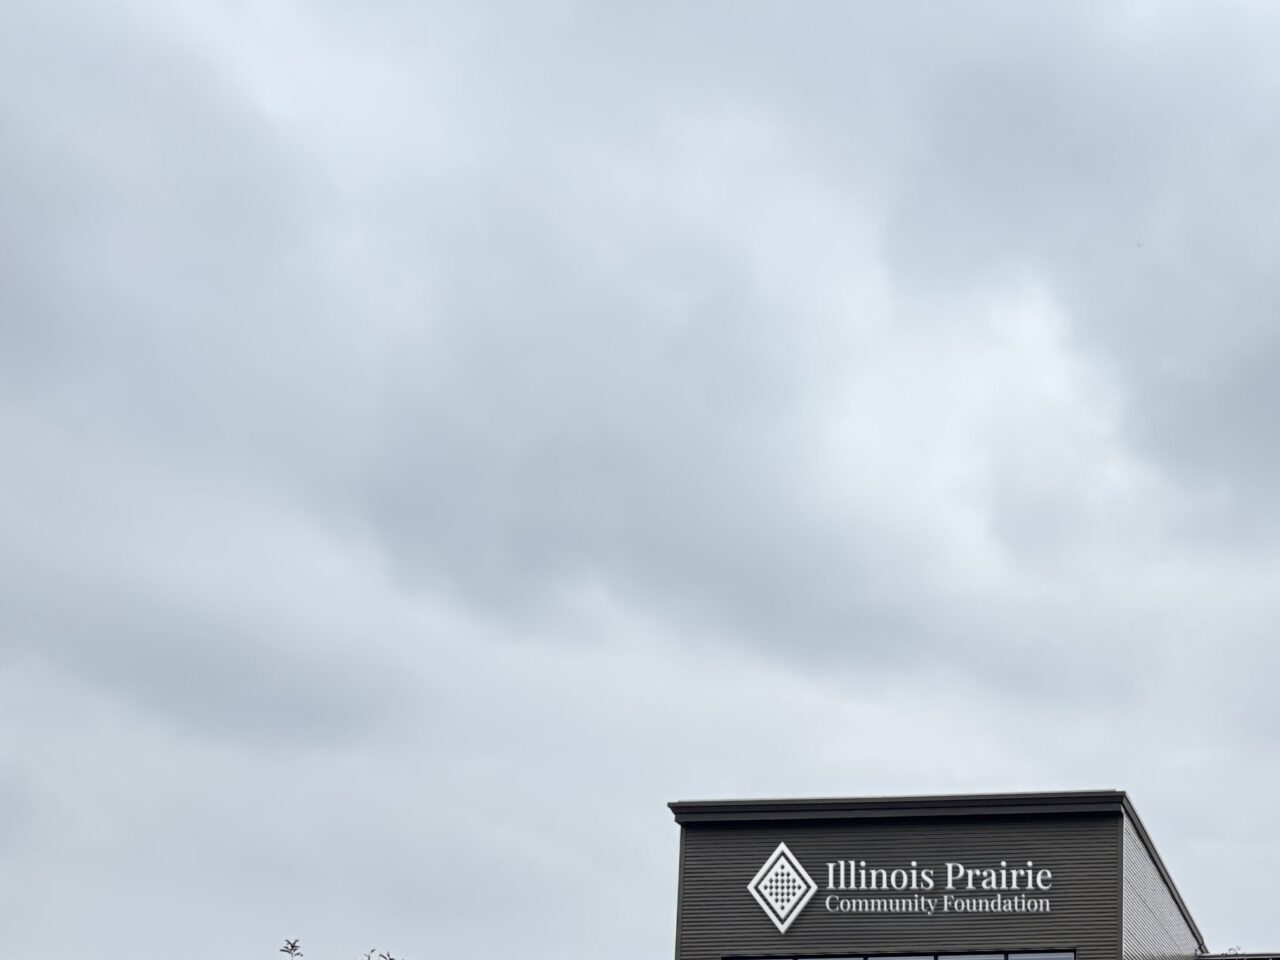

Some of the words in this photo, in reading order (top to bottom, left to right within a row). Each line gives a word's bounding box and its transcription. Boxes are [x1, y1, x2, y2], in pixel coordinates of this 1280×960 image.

[826, 860, 935, 890] Illinois
[945, 860, 1053, 890] Prairie
[825, 894, 938, 916] Community
[943, 893, 1050, 913] Foundation
